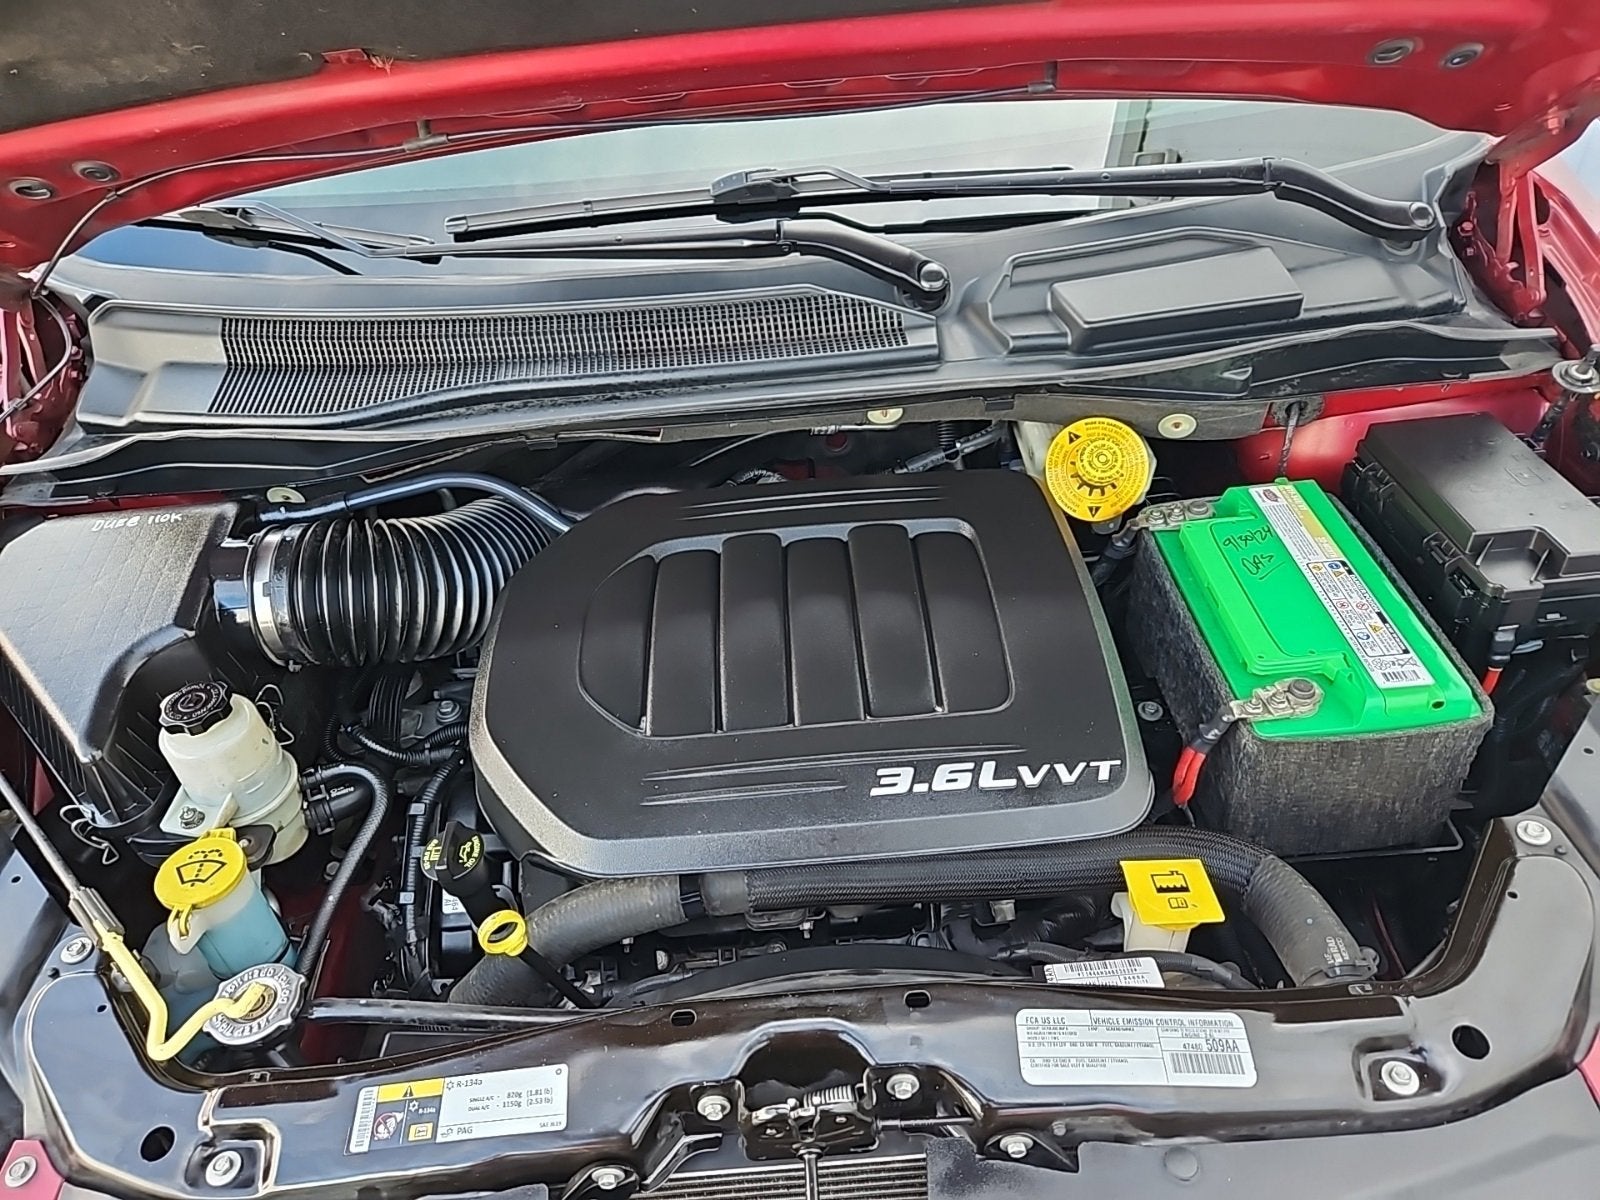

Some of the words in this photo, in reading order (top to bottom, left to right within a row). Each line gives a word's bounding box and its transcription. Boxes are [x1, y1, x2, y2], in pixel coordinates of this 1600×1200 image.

[148, 512, 183, 524] 110K
[1025, 1016, 1039, 1024] FCA
[1041, 1016, 1051, 1024] US
[1052, 1017, 1066, 1025] LLC
[1092, 1017, 1120, 1025] VEHICLE
[1122, 1017, 1154, 1026] EMISSION
[1156, 1018, 1187, 1026] CONTROL
[1187, 1019, 1234, 1027] INFORMATION
[1205, 1038, 1240, 1052] 509AA
[456, 1079, 482, 1088] R-134a
[506, 1091, 522, 1099] 820g
[502, 1100, 522, 1108] 1150g
[456, 1126, 473, 1135] PAG
